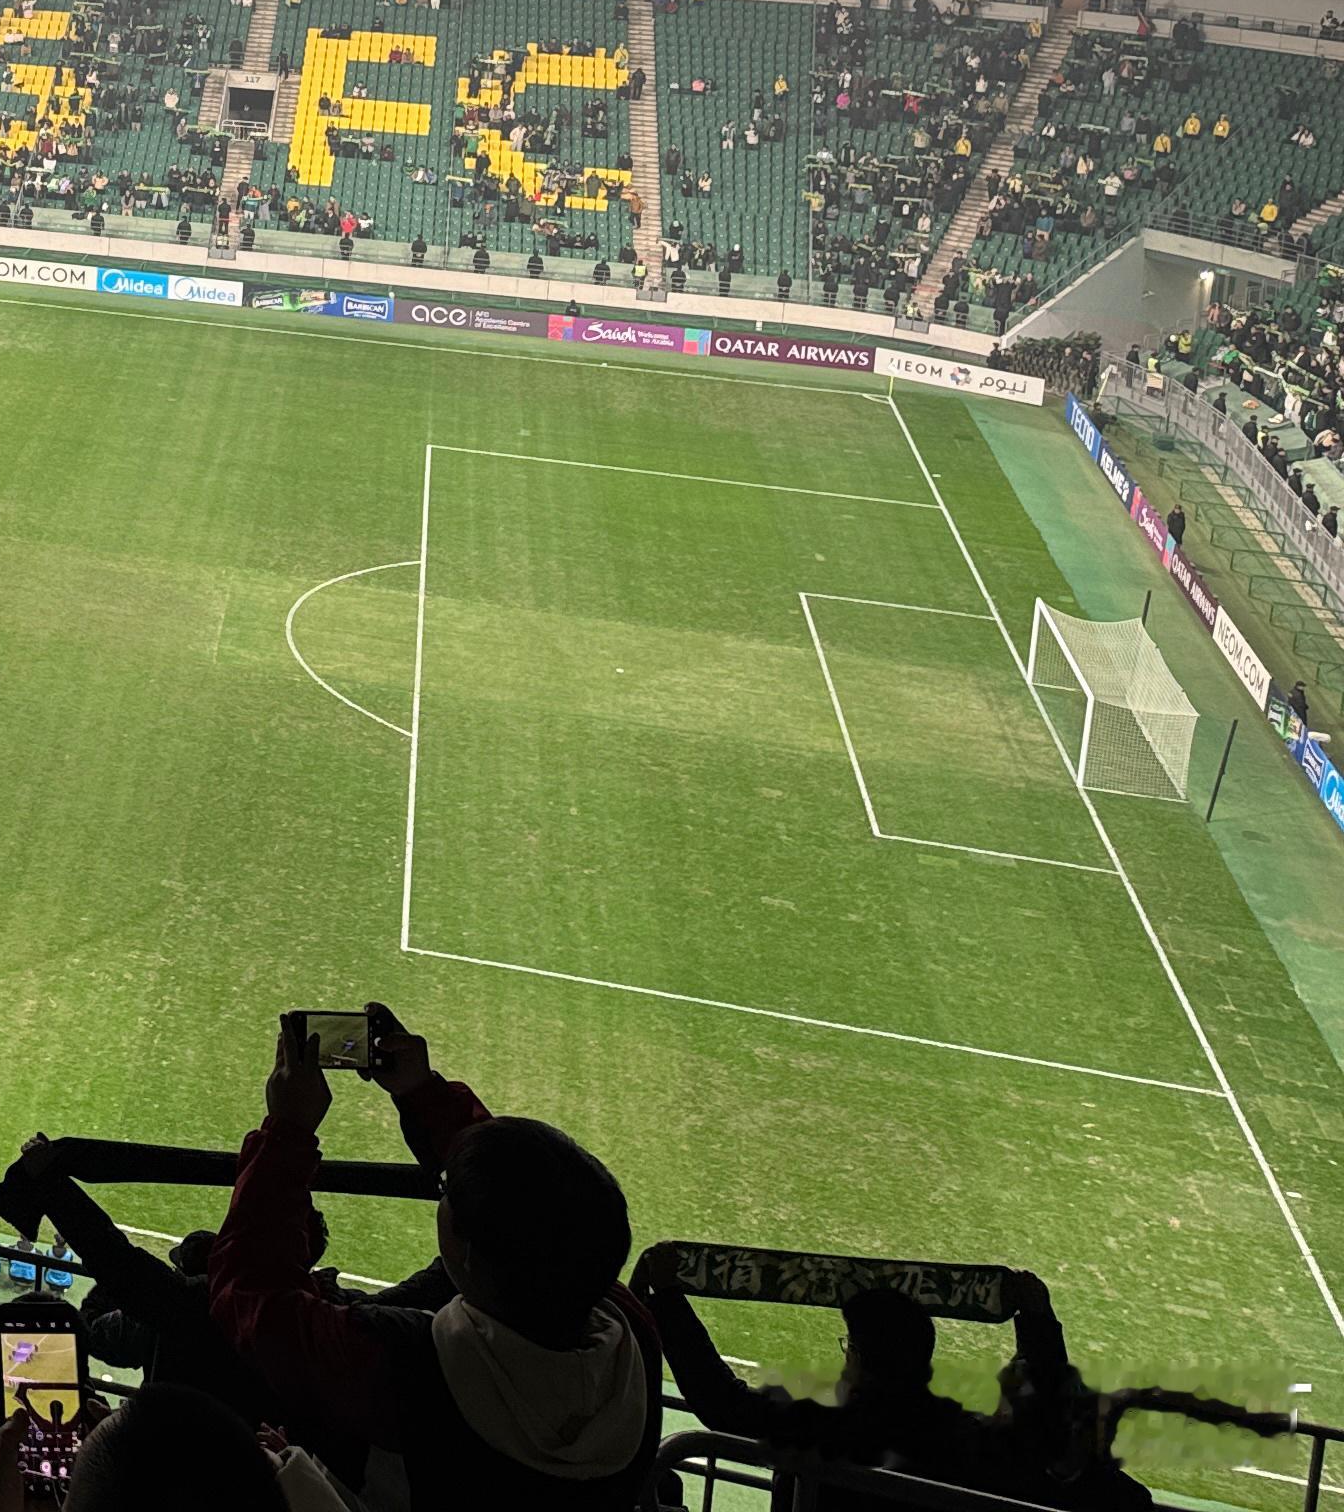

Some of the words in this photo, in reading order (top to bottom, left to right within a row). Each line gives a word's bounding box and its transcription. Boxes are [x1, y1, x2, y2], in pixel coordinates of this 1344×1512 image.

[114, 275, 163, 295] Midea
[186, 286, 237, 303] Midea
[411, 305, 467, 326] ace
[582, 321, 637, 344] Saudi
[714, 336, 780, 358] QATAR
[785, 344, 870, 369] AIRWAYS
[1070, 400, 1094, 453] TECNO
[1099, 448, 1125, 497] KELME
[1171, 553, 1192, 594] QATAR
[1191, 581, 1217, 626] AIRWAYS
[1218, 618, 1265, 699] NEOM.COM
